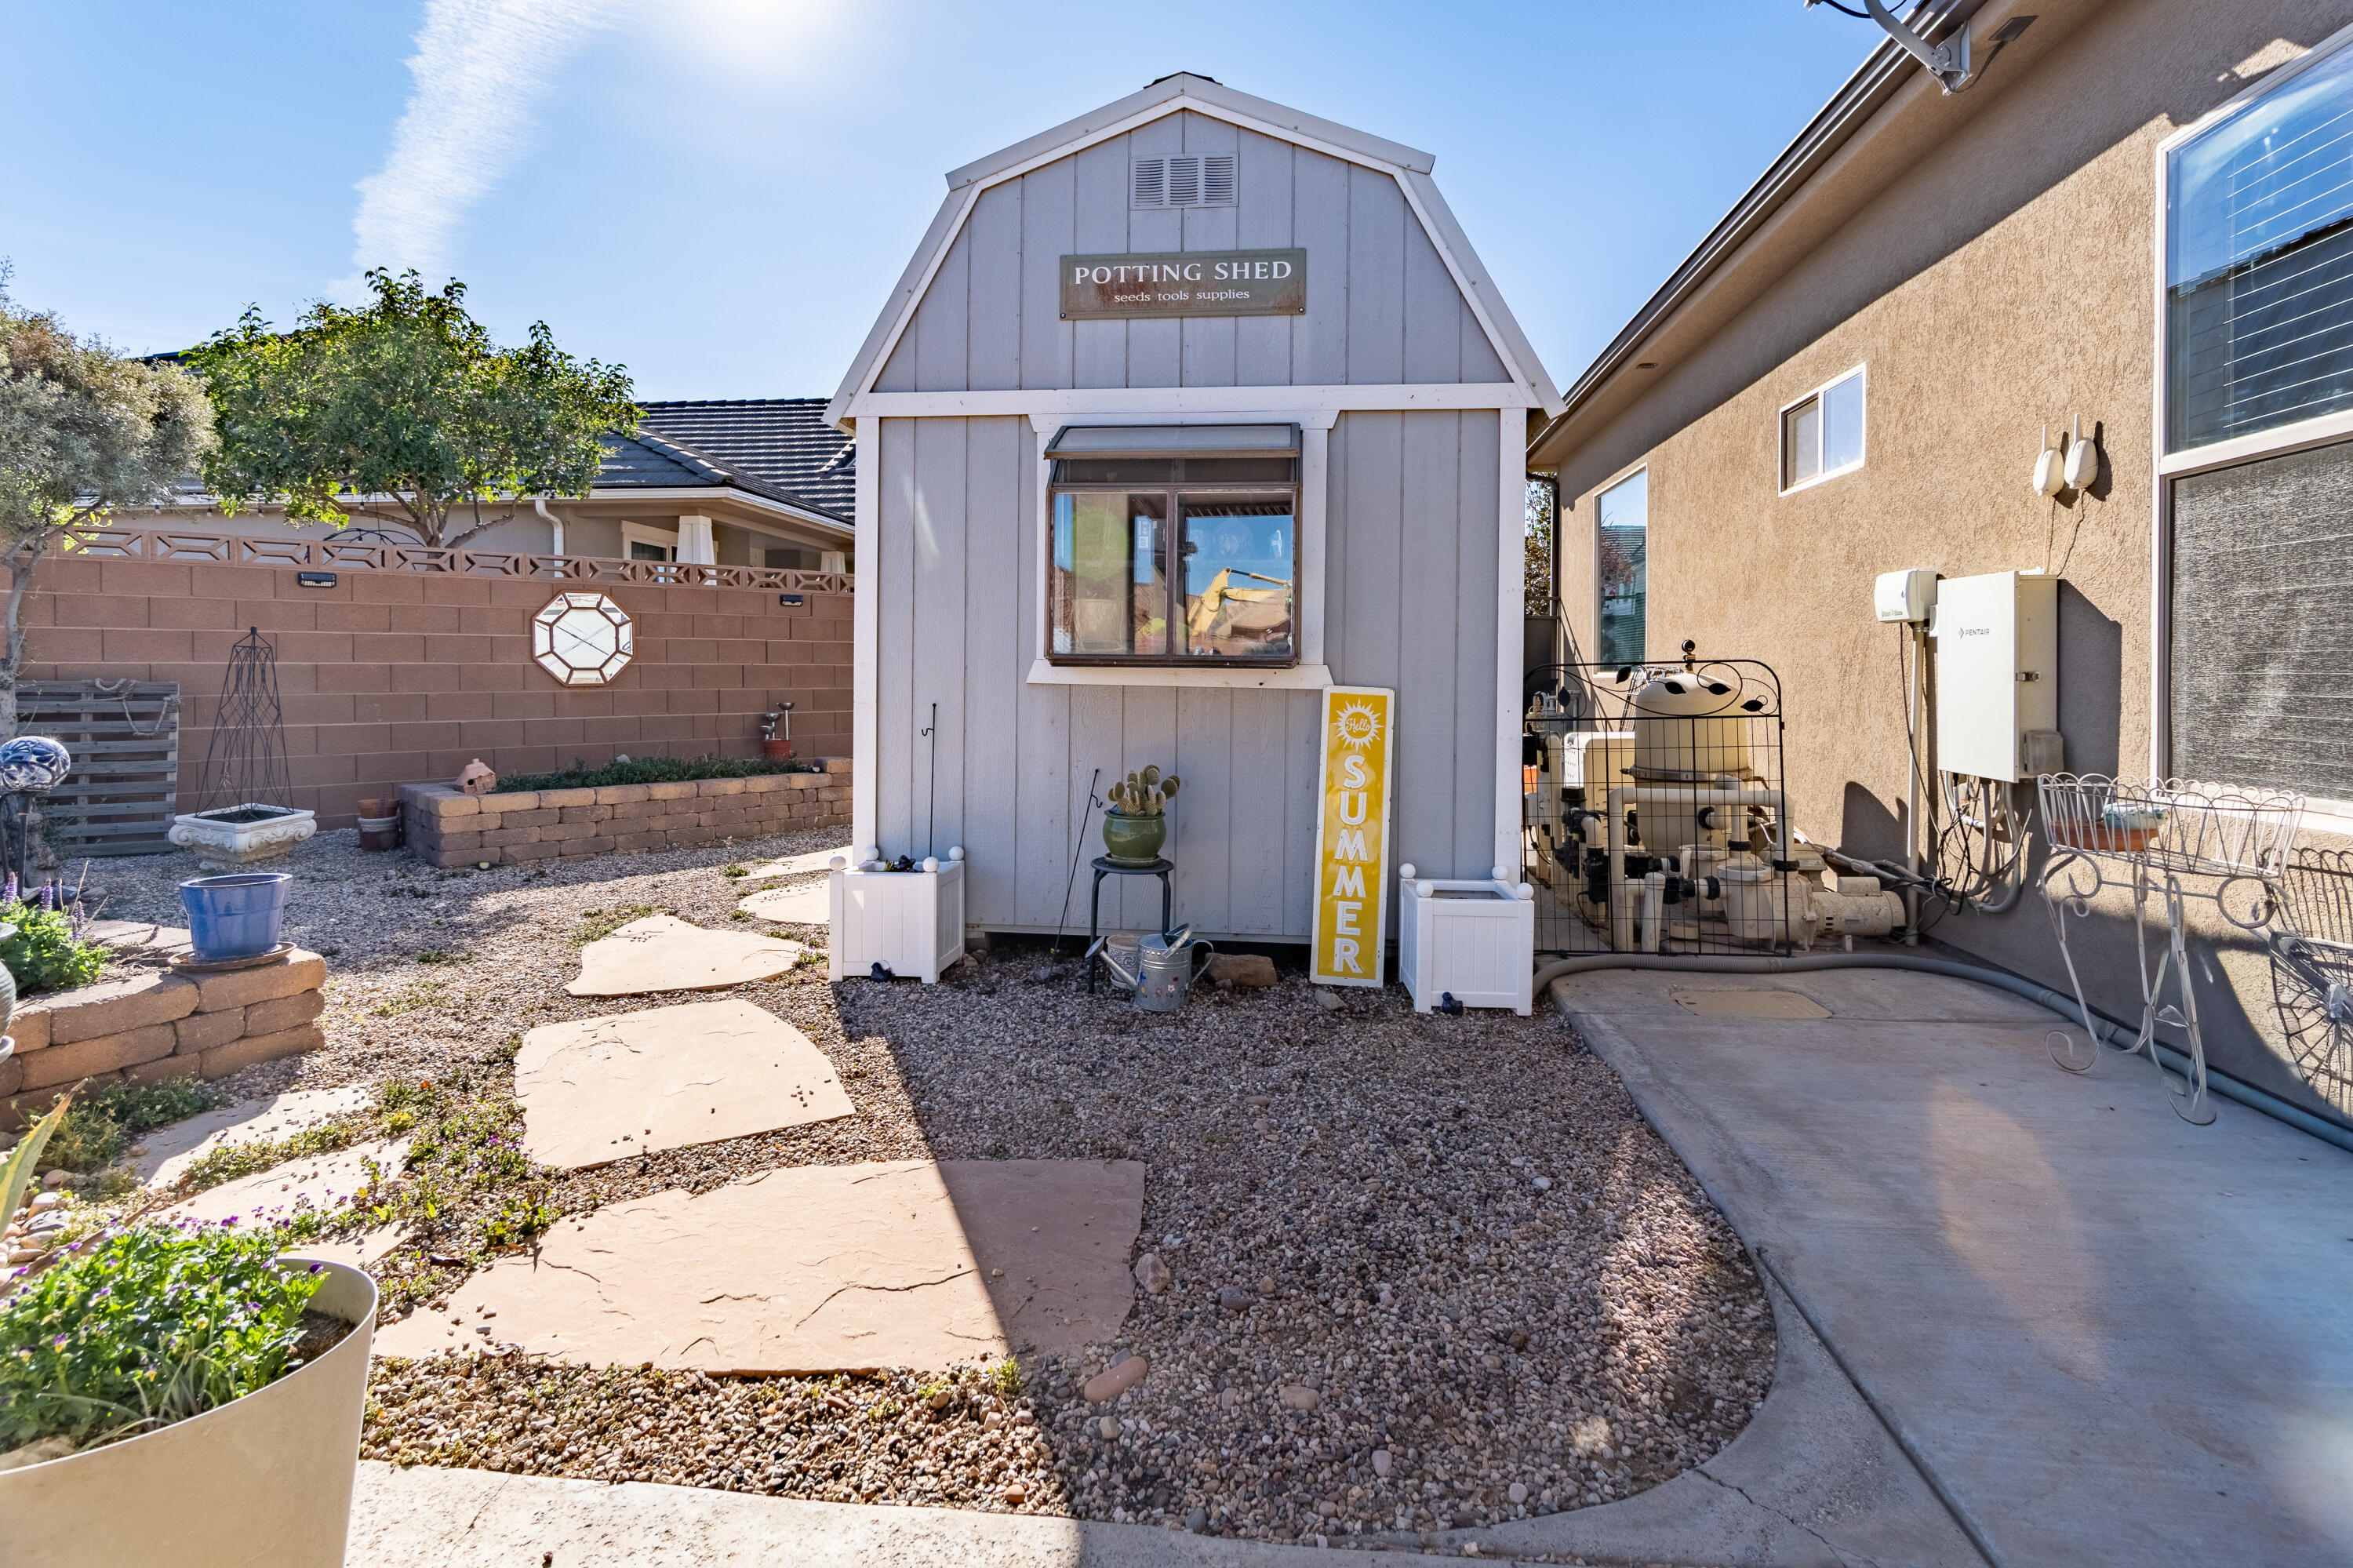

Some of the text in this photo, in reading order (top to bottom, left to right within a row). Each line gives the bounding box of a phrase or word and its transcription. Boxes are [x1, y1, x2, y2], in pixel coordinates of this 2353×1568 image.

[1075, 260, 1292, 285] POTTING SHED
[1114, 289, 1250, 303] seeds tools supplies
[1345, 717, 1372, 733] Hello
[1333, 754, 1368, 974] SUMMER
